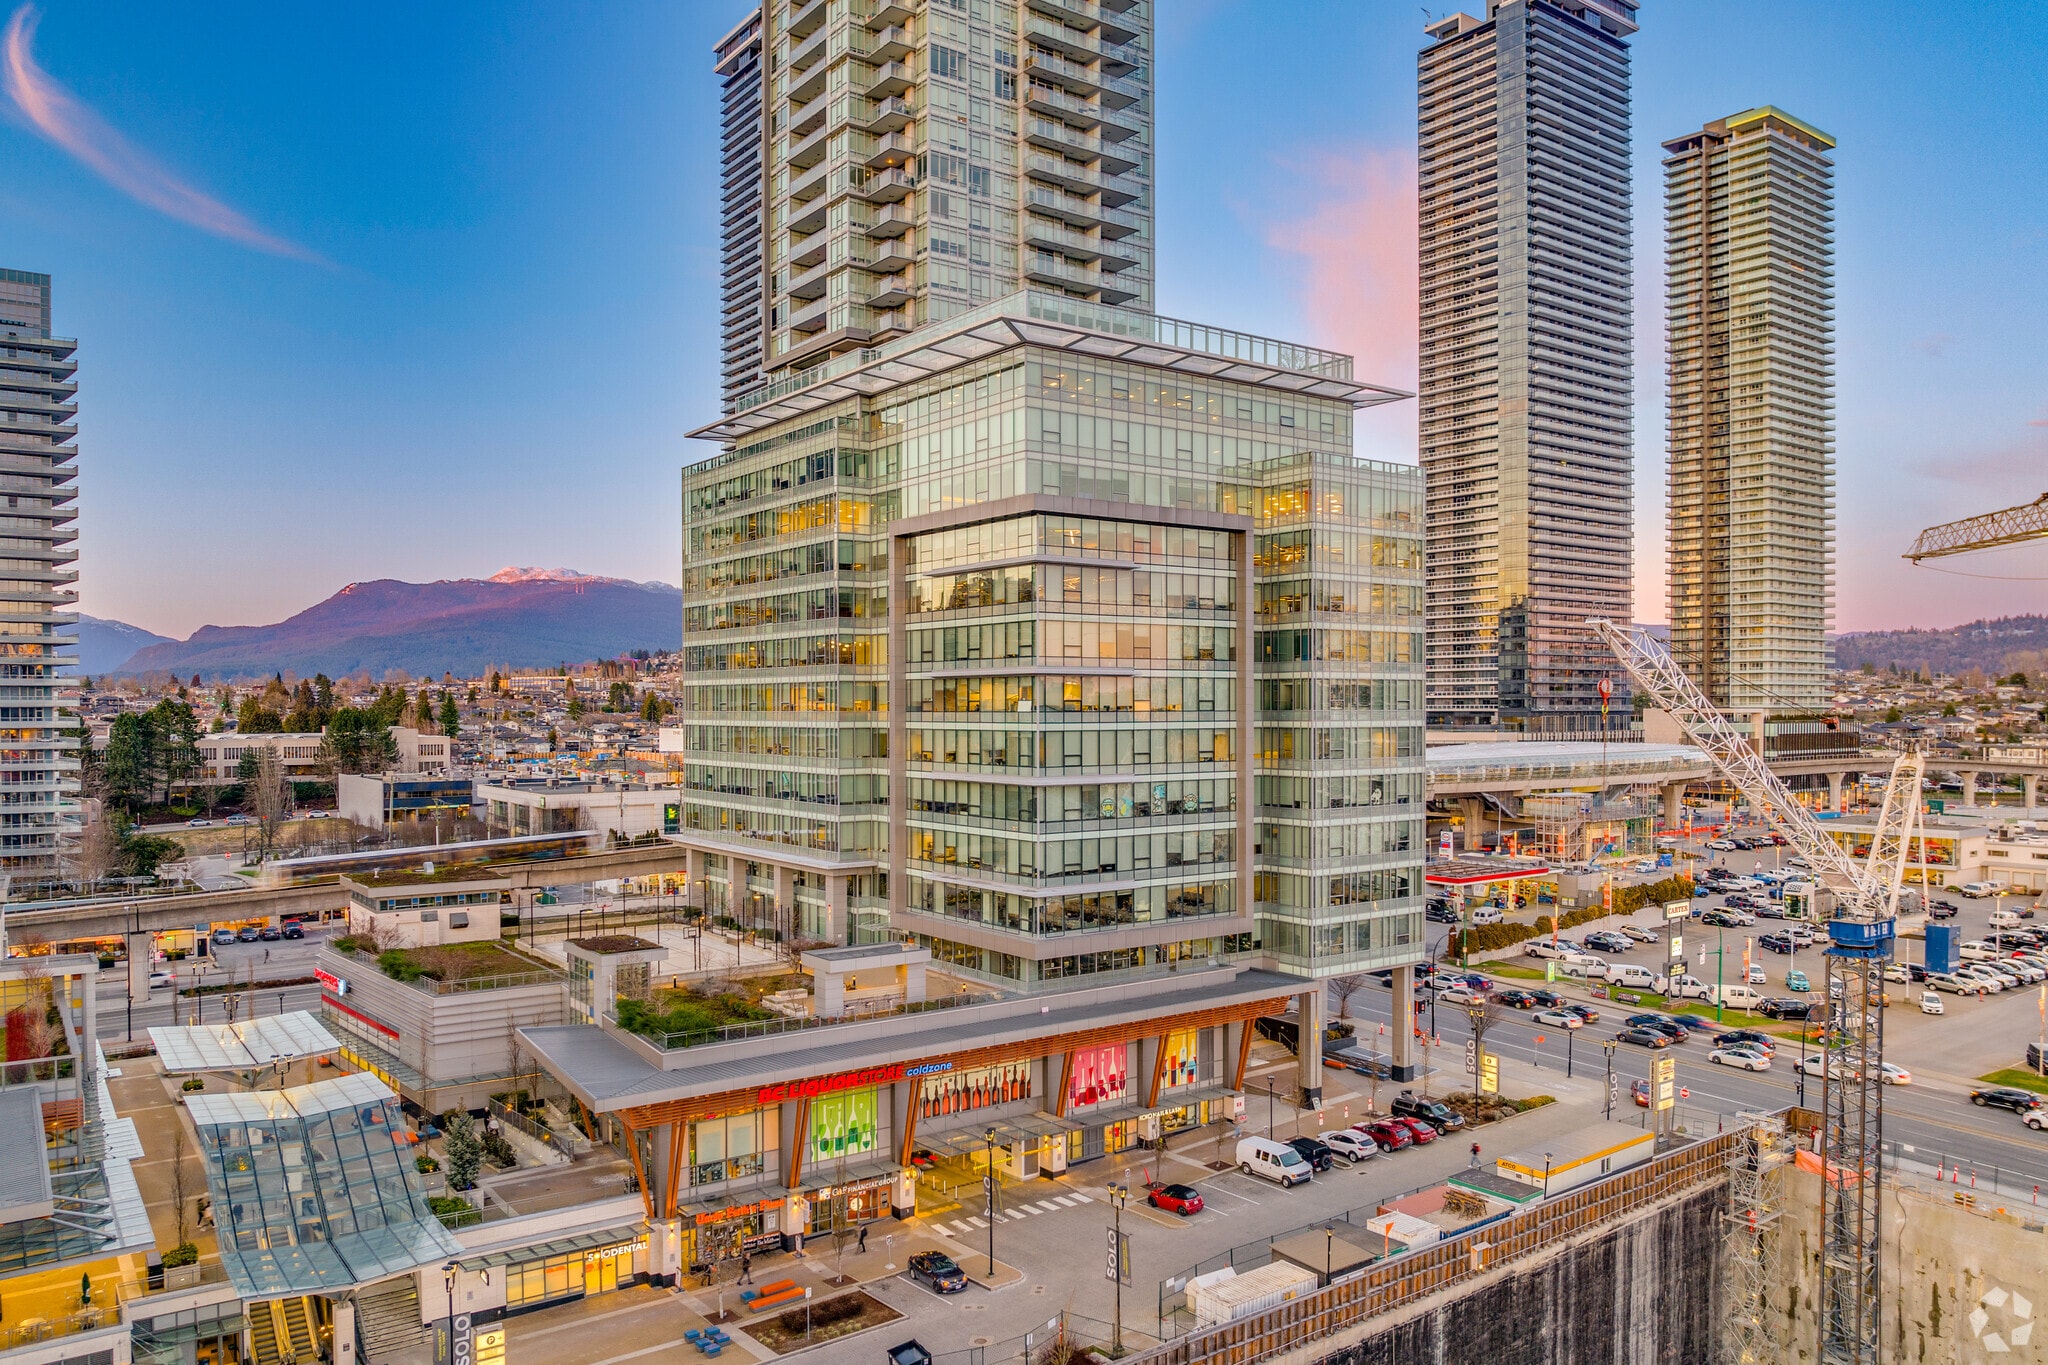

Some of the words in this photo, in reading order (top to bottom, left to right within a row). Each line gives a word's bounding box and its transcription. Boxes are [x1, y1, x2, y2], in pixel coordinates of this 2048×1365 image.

[1668, 905, 1688, 915] CARTER
[1466, 1040, 1476, 1072] SOLO
[758, 1085, 785, 1103] BC
[906, 1061, 953, 1077] coldzone
[1609, 1073, 1618, 1109] SOLO
[1501, 1161, 1516, 1170] ATCO
[847, 1181, 878, 1193] FINANCIAL
[878, 1176, 899, 1186] GROUP
[1106, 1230, 1117, 1279] SOLO
[454, 1316, 470, 1365] SOLO
